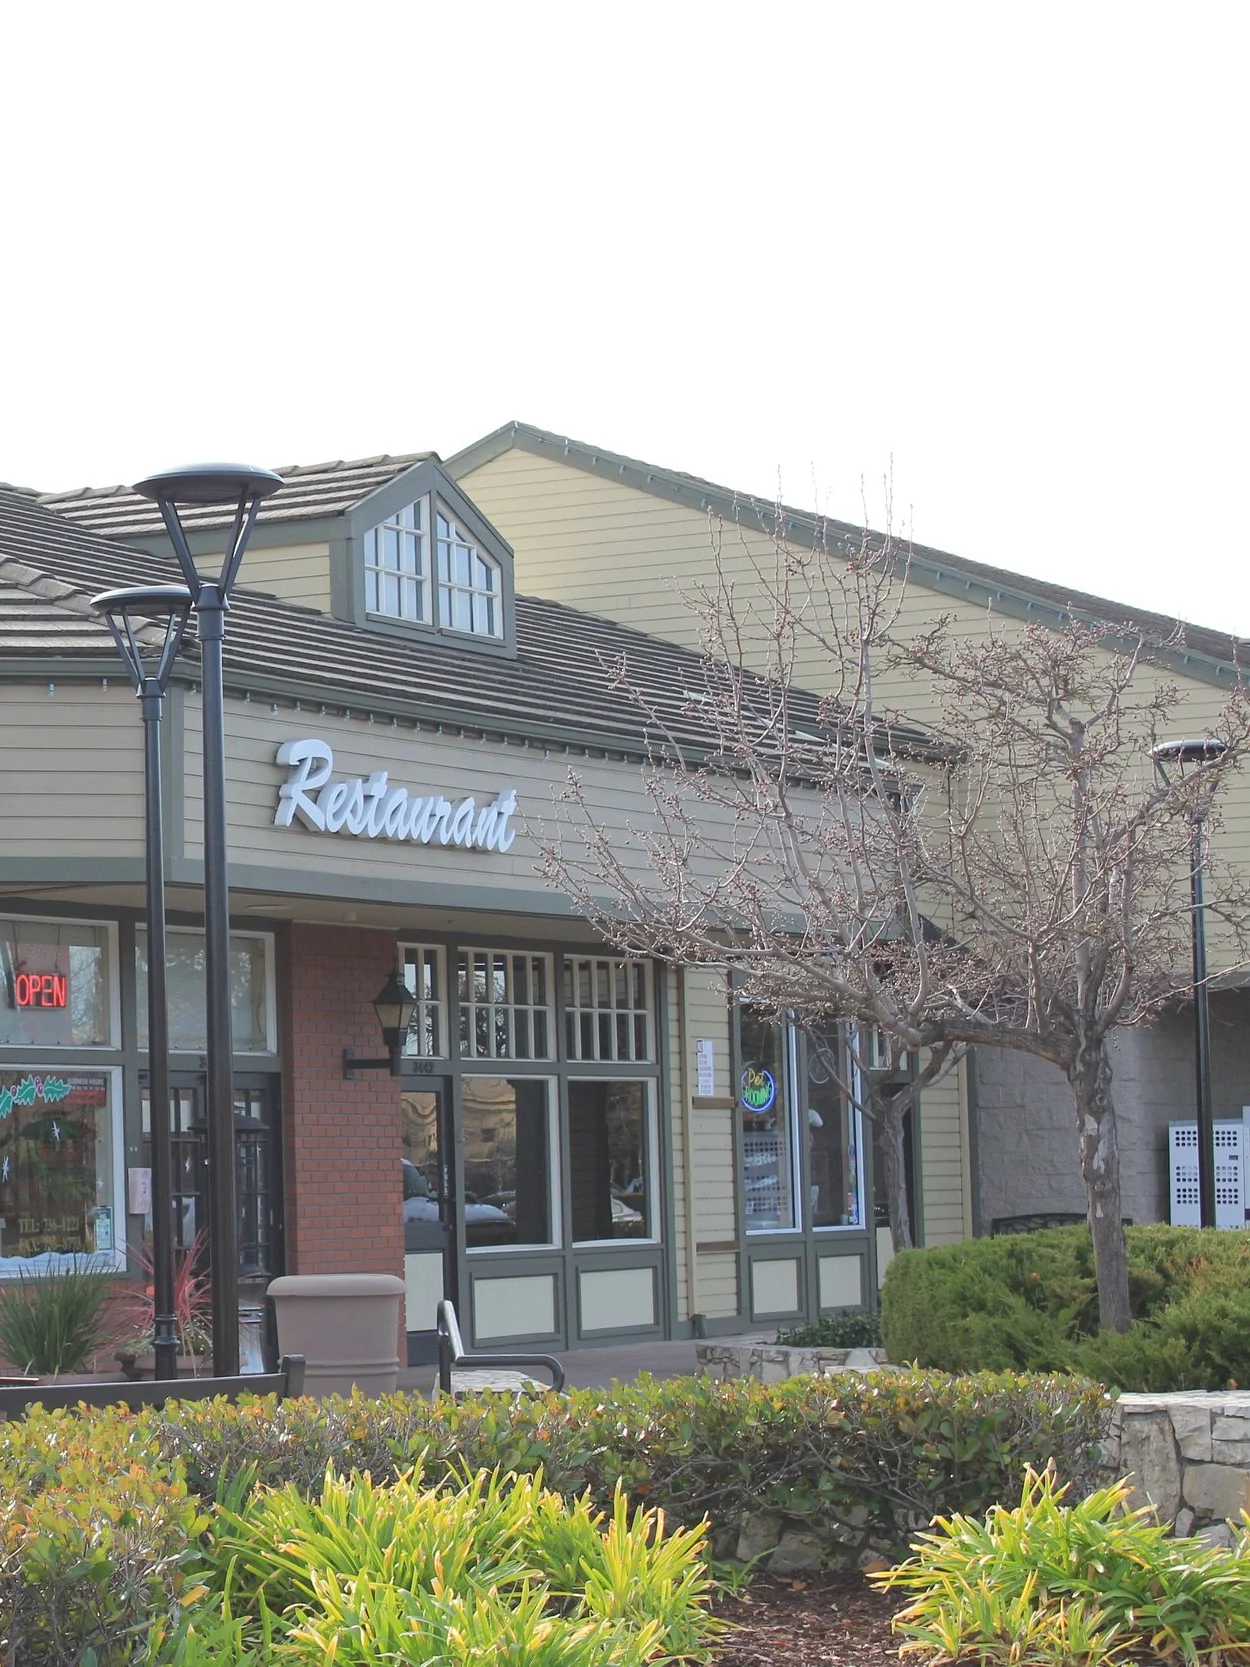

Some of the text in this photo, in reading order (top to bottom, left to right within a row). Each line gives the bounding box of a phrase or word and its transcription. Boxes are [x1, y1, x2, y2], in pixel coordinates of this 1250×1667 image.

[273, 738, 518, 853] Restaurant
[16, 973, 67, 1007] OPEN
[747, 1066, 765, 1087] Pet
